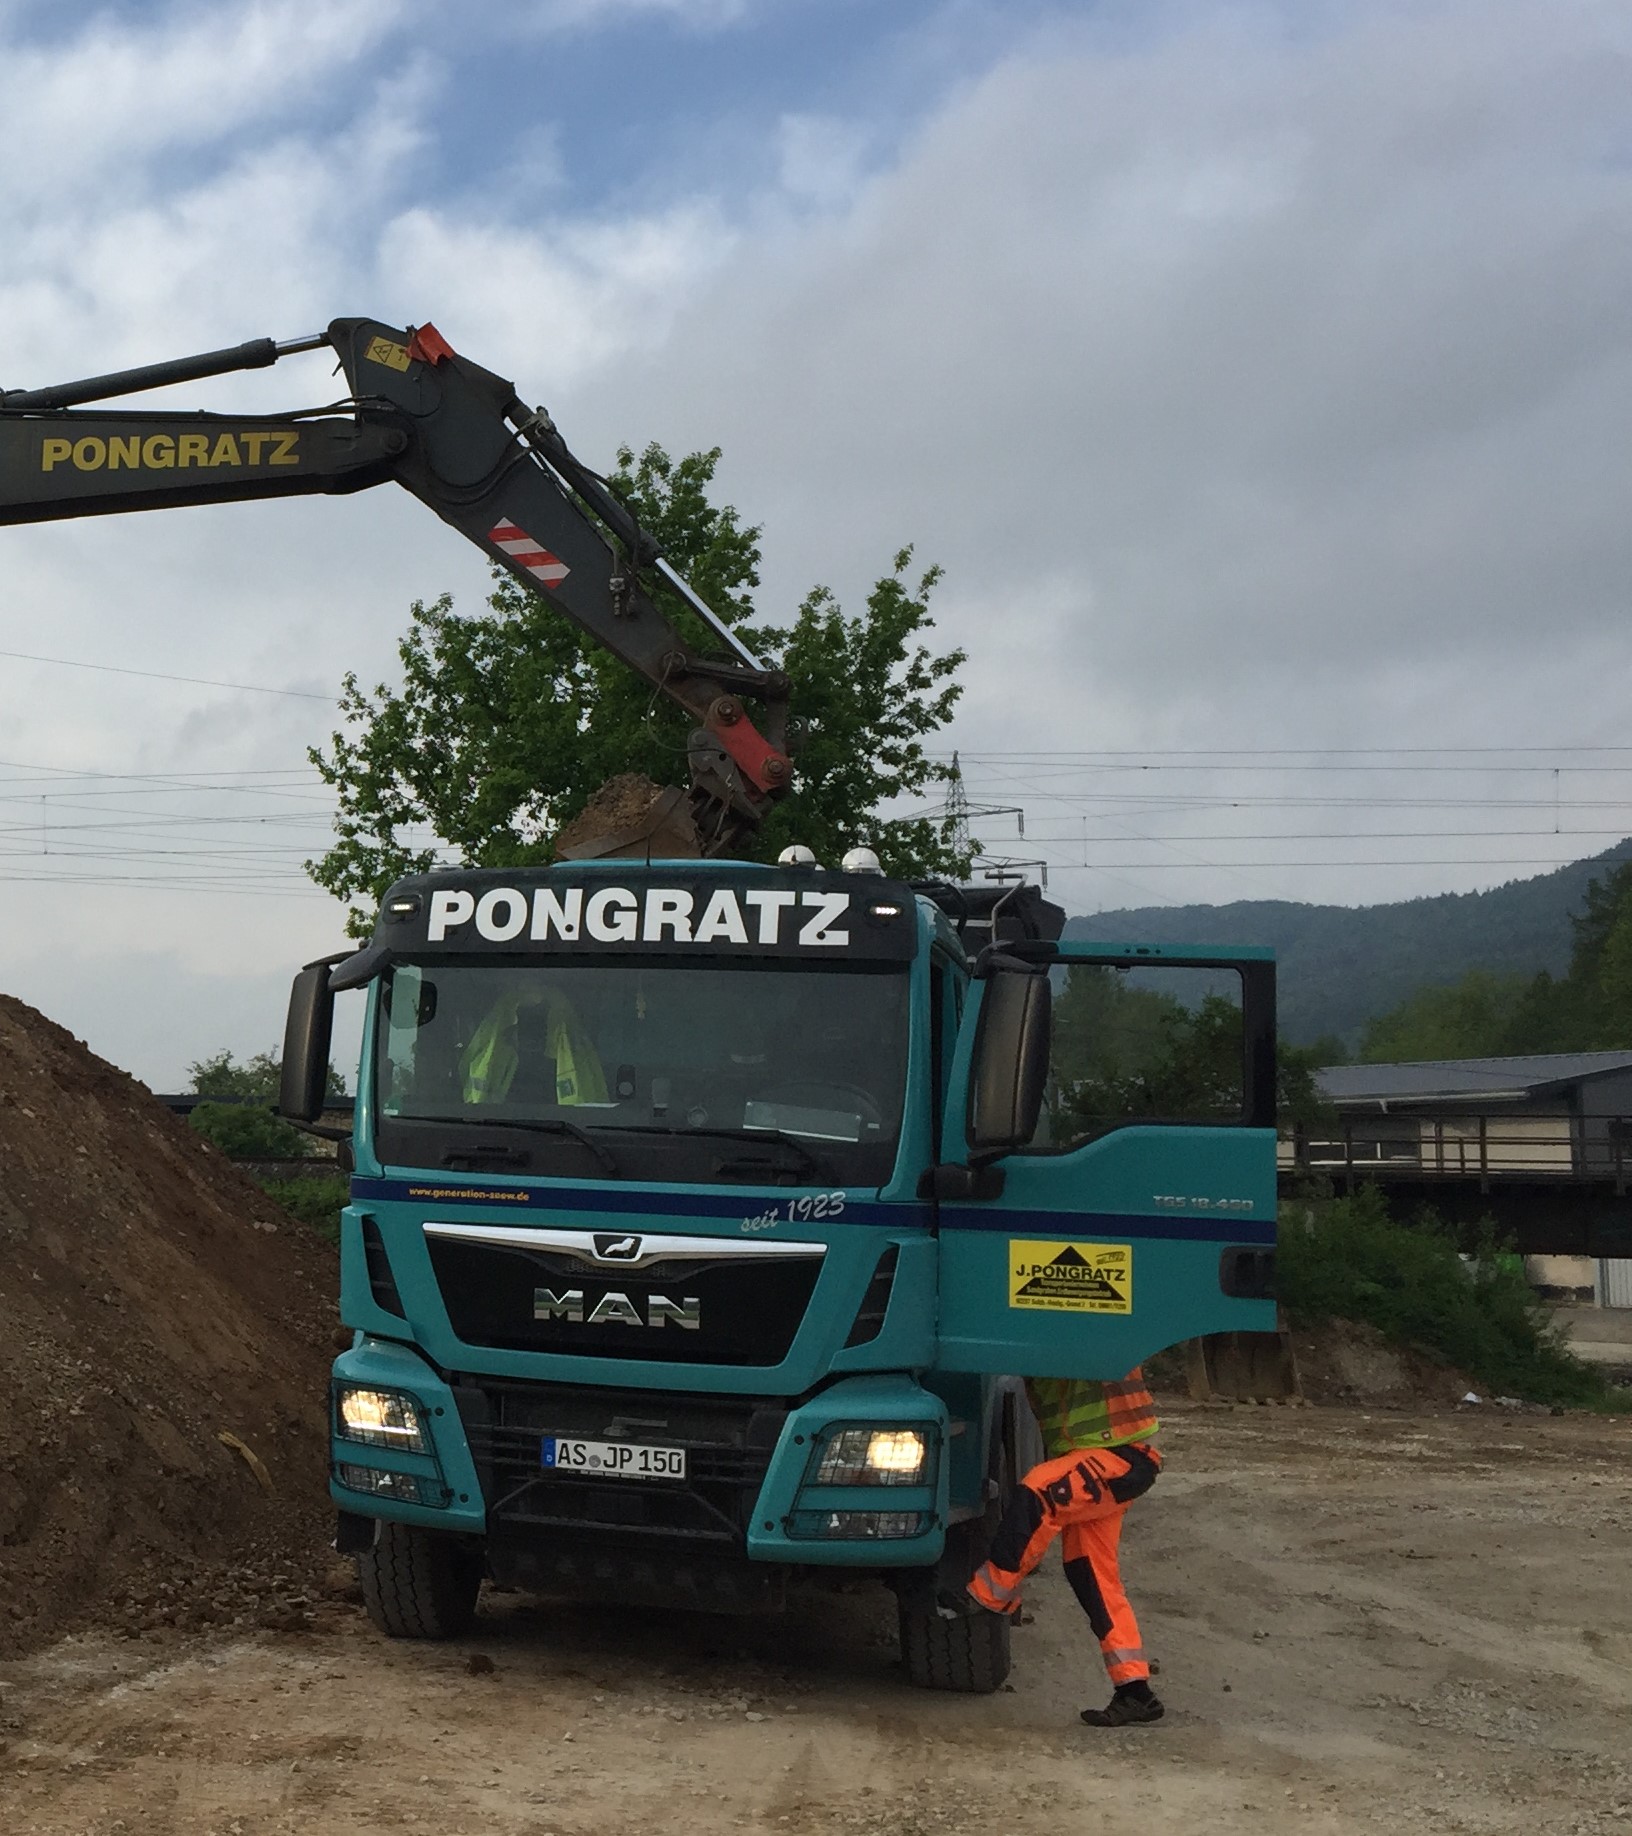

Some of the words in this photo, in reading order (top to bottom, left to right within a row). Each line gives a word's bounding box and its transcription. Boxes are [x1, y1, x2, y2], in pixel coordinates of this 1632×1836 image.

[41, 431, 300, 472] PONGRATZ
[426, 886, 850, 946] PONGRATZ
[740, 1207, 779, 1232] seit
[787, 1191, 846, 1222] 1923
[1015, 1264, 1126, 1281] J.PONGRATZ
[533, 1286, 701, 1330] MAN
[557, 1442, 587, 1466] AS
[603, 1446, 633, 1470] JP
[638, 1449, 683, 1474] 150
